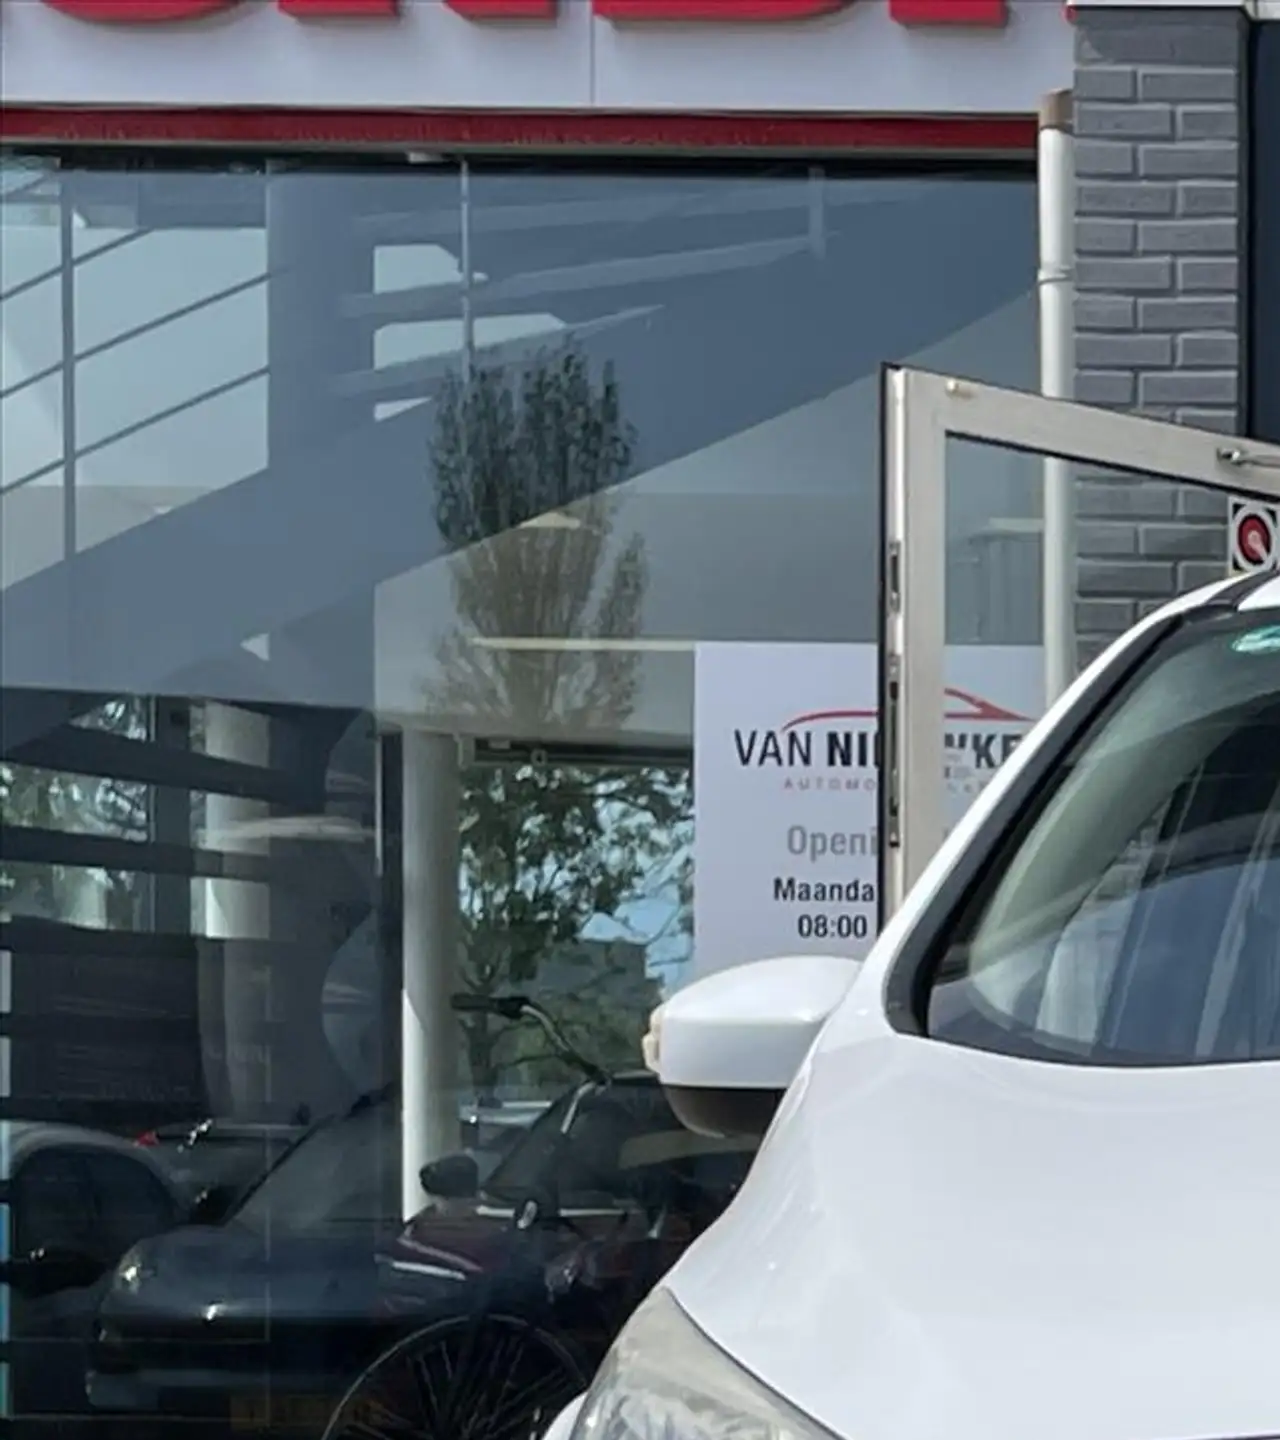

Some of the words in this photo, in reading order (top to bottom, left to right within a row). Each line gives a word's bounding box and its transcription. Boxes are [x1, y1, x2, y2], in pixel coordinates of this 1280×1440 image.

[734, 730, 812, 768] VAN
[773, 877, 876, 902] Maanda
[798, 914, 868, 938] 08:00
